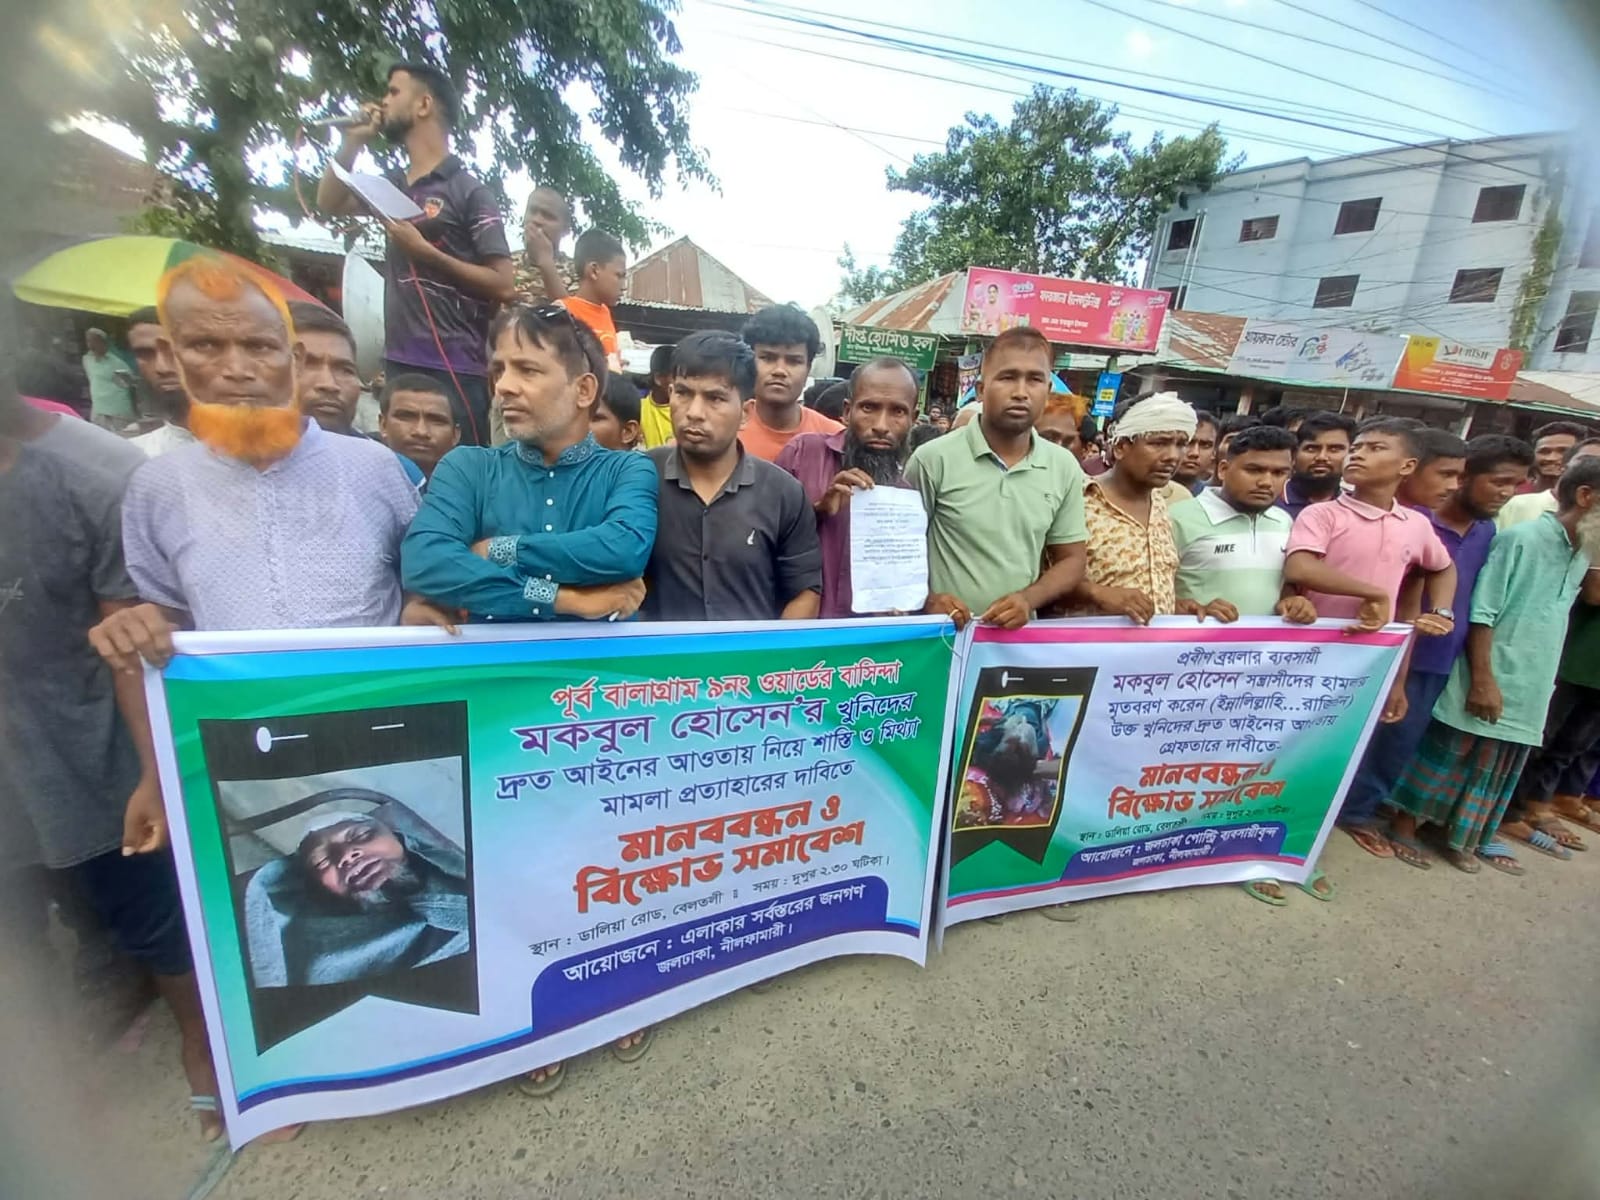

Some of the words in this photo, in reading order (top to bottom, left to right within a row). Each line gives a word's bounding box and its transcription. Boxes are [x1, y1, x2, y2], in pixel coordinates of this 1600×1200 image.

[1214, 544, 1235, 554] NIKE
[1214, 650, 1263, 666] ব্রয়লার
[1267, 646, 1322, 665] ব্যবসায়ী
[551, 676, 598, 718] পূর্ব
[601, 677, 700, 707] বালাগ্রাম
[708, 675, 751, 699] ৯নং
[757, 661, 836, 695] ওয়ার্ডের
[839, 657, 902, 688] বাসিন্দা
[1113, 673, 1174, 695] মকবুল
[1176, 669, 1244, 692] হোসেন
[512, 716, 657, 754] মকবুল
[837, 692, 917, 726] খুনিদের
[1143, 717, 1194, 738] খুনিদের
[1194, 719, 1226, 733] দ্রুত
[1229, 714, 1286, 732] আইনের
[1167, 698, 1208, 713] করেন
[497, 770, 556, 801] দ্রুত
[563, 756, 661, 786] আইনের
[667, 743, 757, 773] আওতায়
[762, 735, 807, 762] নিয়ে
[812, 726, 855, 753] শাস্তি
[860, 729, 874, 745] ও
[879, 717, 920, 744] মিথ্যা
[1160, 739, 1223, 755] গ্রেফতারে
[600, 785, 672, 817] মামলা
[679, 771, 788, 806] প্রত্যাহারের
[794, 759, 856, 787] দাবিতে
[1139, 763, 1264, 787] মানববন্ধন
[1108, 785, 1196, 820] বিক্ষোভ
[618, 800, 812, 862] মানববন্ধন
[820, 795, 841, 821] ও
[572, 852, 725, 914] বিক্ষোভ
[732, 821, 866, 874] সমাবেশ
[528, 937, 561, 957] স্থান
[577, 918, 625, 942] ডালিয়া
[752, 877, 780, 893] সময়
[792, 867, 818, 888] দুপুর
[562, 939, 661, 982] আয়োজনে
[681, 914, 747, 944] এলাকার
[751, 895, 815, 925] সর্বস্তরের
[819, 883, 866, 905] জনগণ
